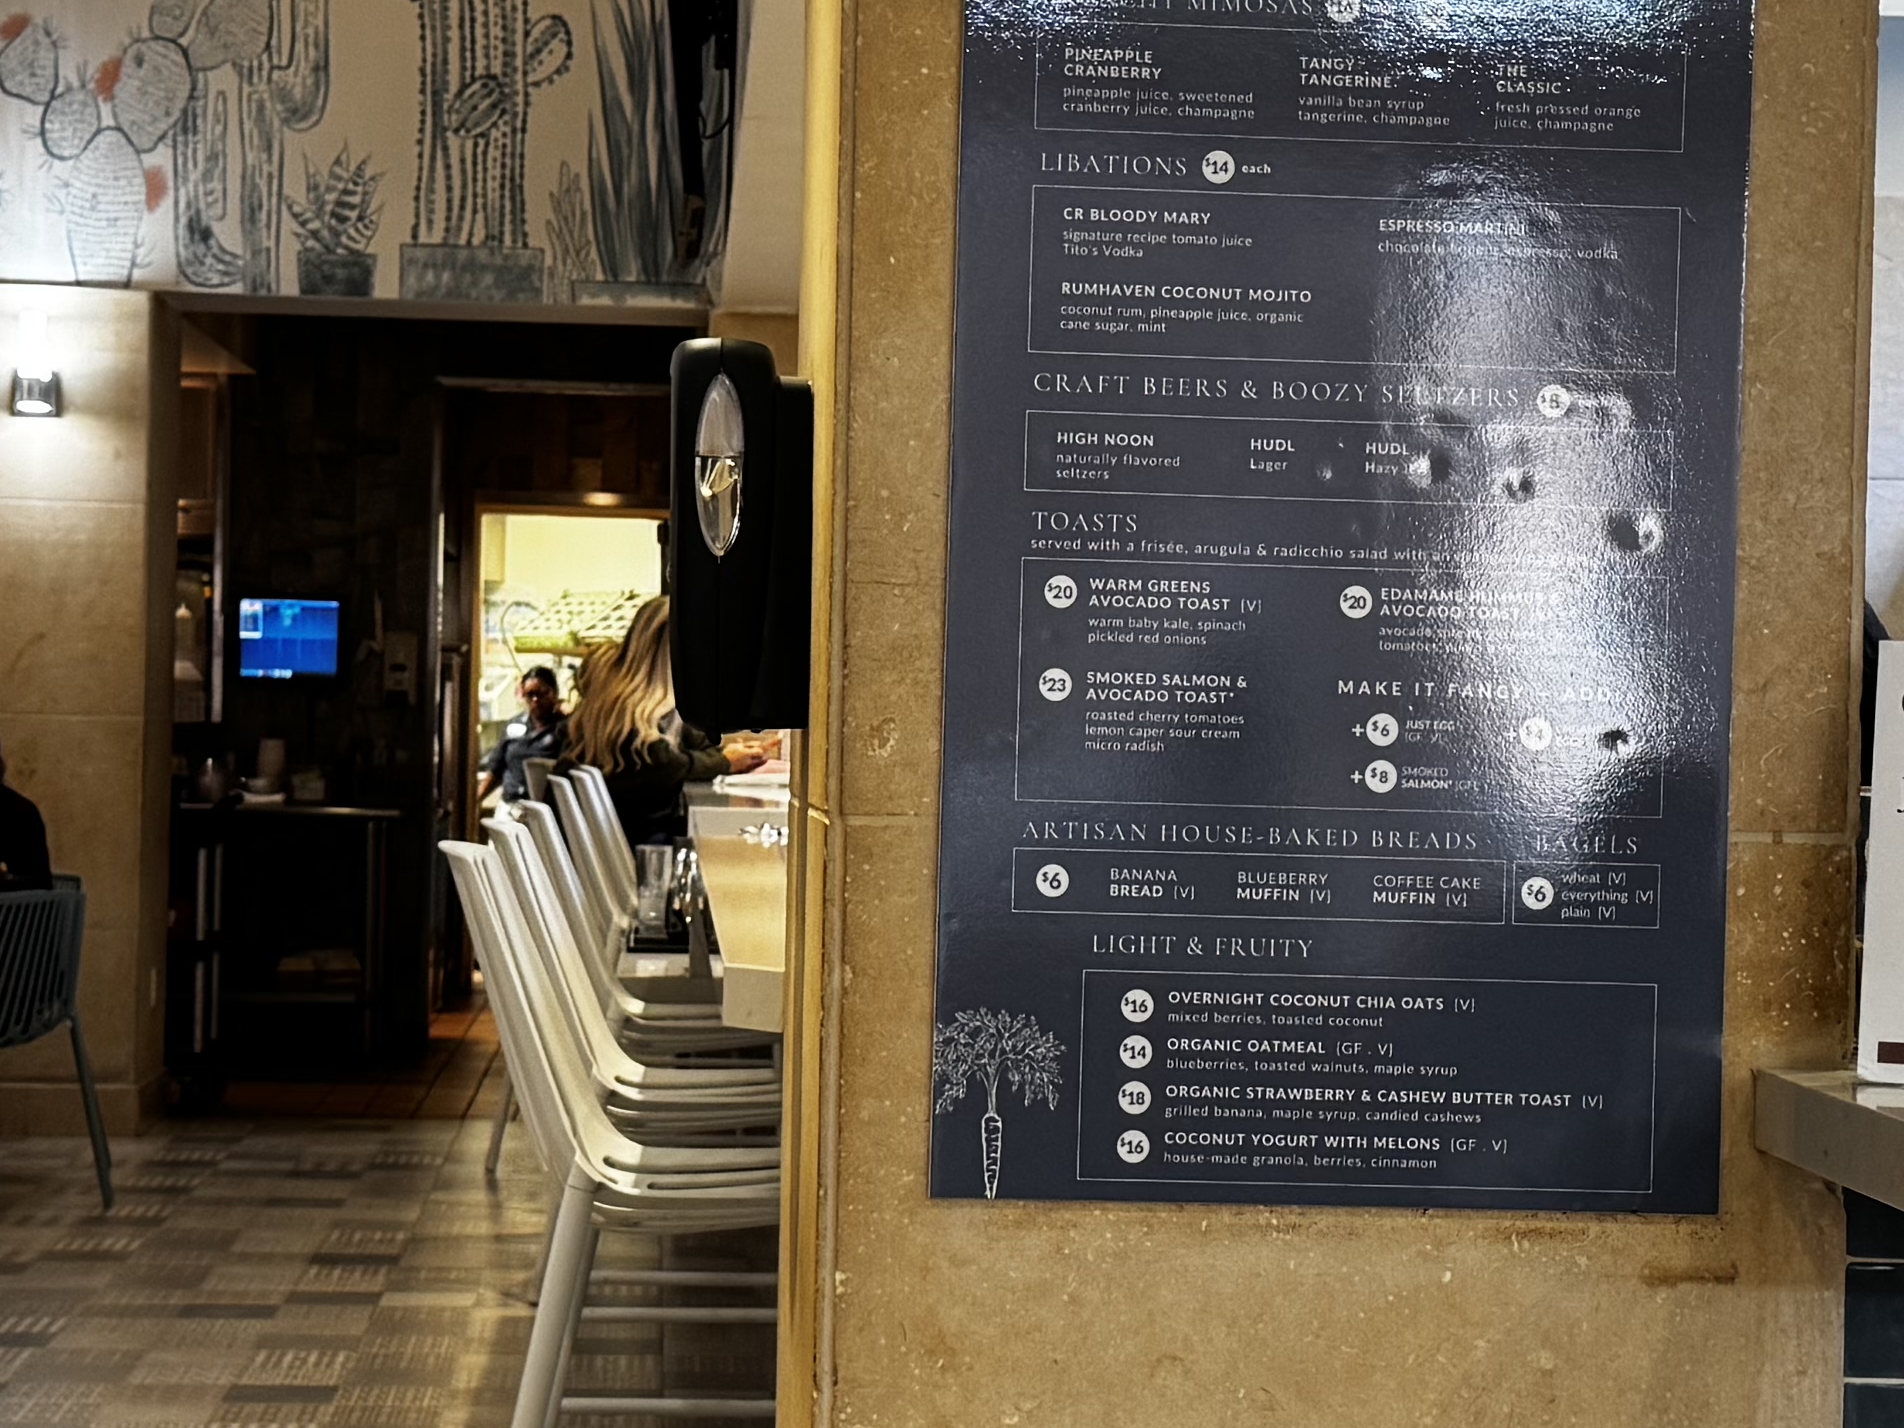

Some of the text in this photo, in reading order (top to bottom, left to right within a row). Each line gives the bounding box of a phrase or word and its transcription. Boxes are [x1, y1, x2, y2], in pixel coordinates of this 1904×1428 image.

[1042, 153, 1228, 175] LIBATIONS $14
[1064, 207, 1210, 224] CR BLOODY MARY
[1062, 282, 1311, 302] RUMHAVEN COCONUT MOJITO
[1034, 373, 1367, 401] CRAFT BEERS & BOOZY
[1032, 511, 1137, 533] TOASTS
[1048, 578, 1210, 599] $20 WARM GREENS
[1089, 595, 1229, 610] AVOCADO TOAST
[1042, 671, 1246, 692] $23 SMOKED SALMON &
[1022, 821, 1475, 849] ARTISAN HOUSE-BAKED BREADS
[1093, 935, 1311, 957] LIGHT & FRUITY
[1124, 991, 1443, 1013] $16 OVERNIGHT COCONUT CHIA OATS
[1123, 1038, 1325, 1059] $14 ORGANIC OATMEAL
[1122, 1085, 1570, 1106] $18 ORGANIC STRAWBERRY & CASHEW BUTTER TOAST
[1121, 1132, 1439, 1154] $16 COCONUT YOGURT WITH MELONS
